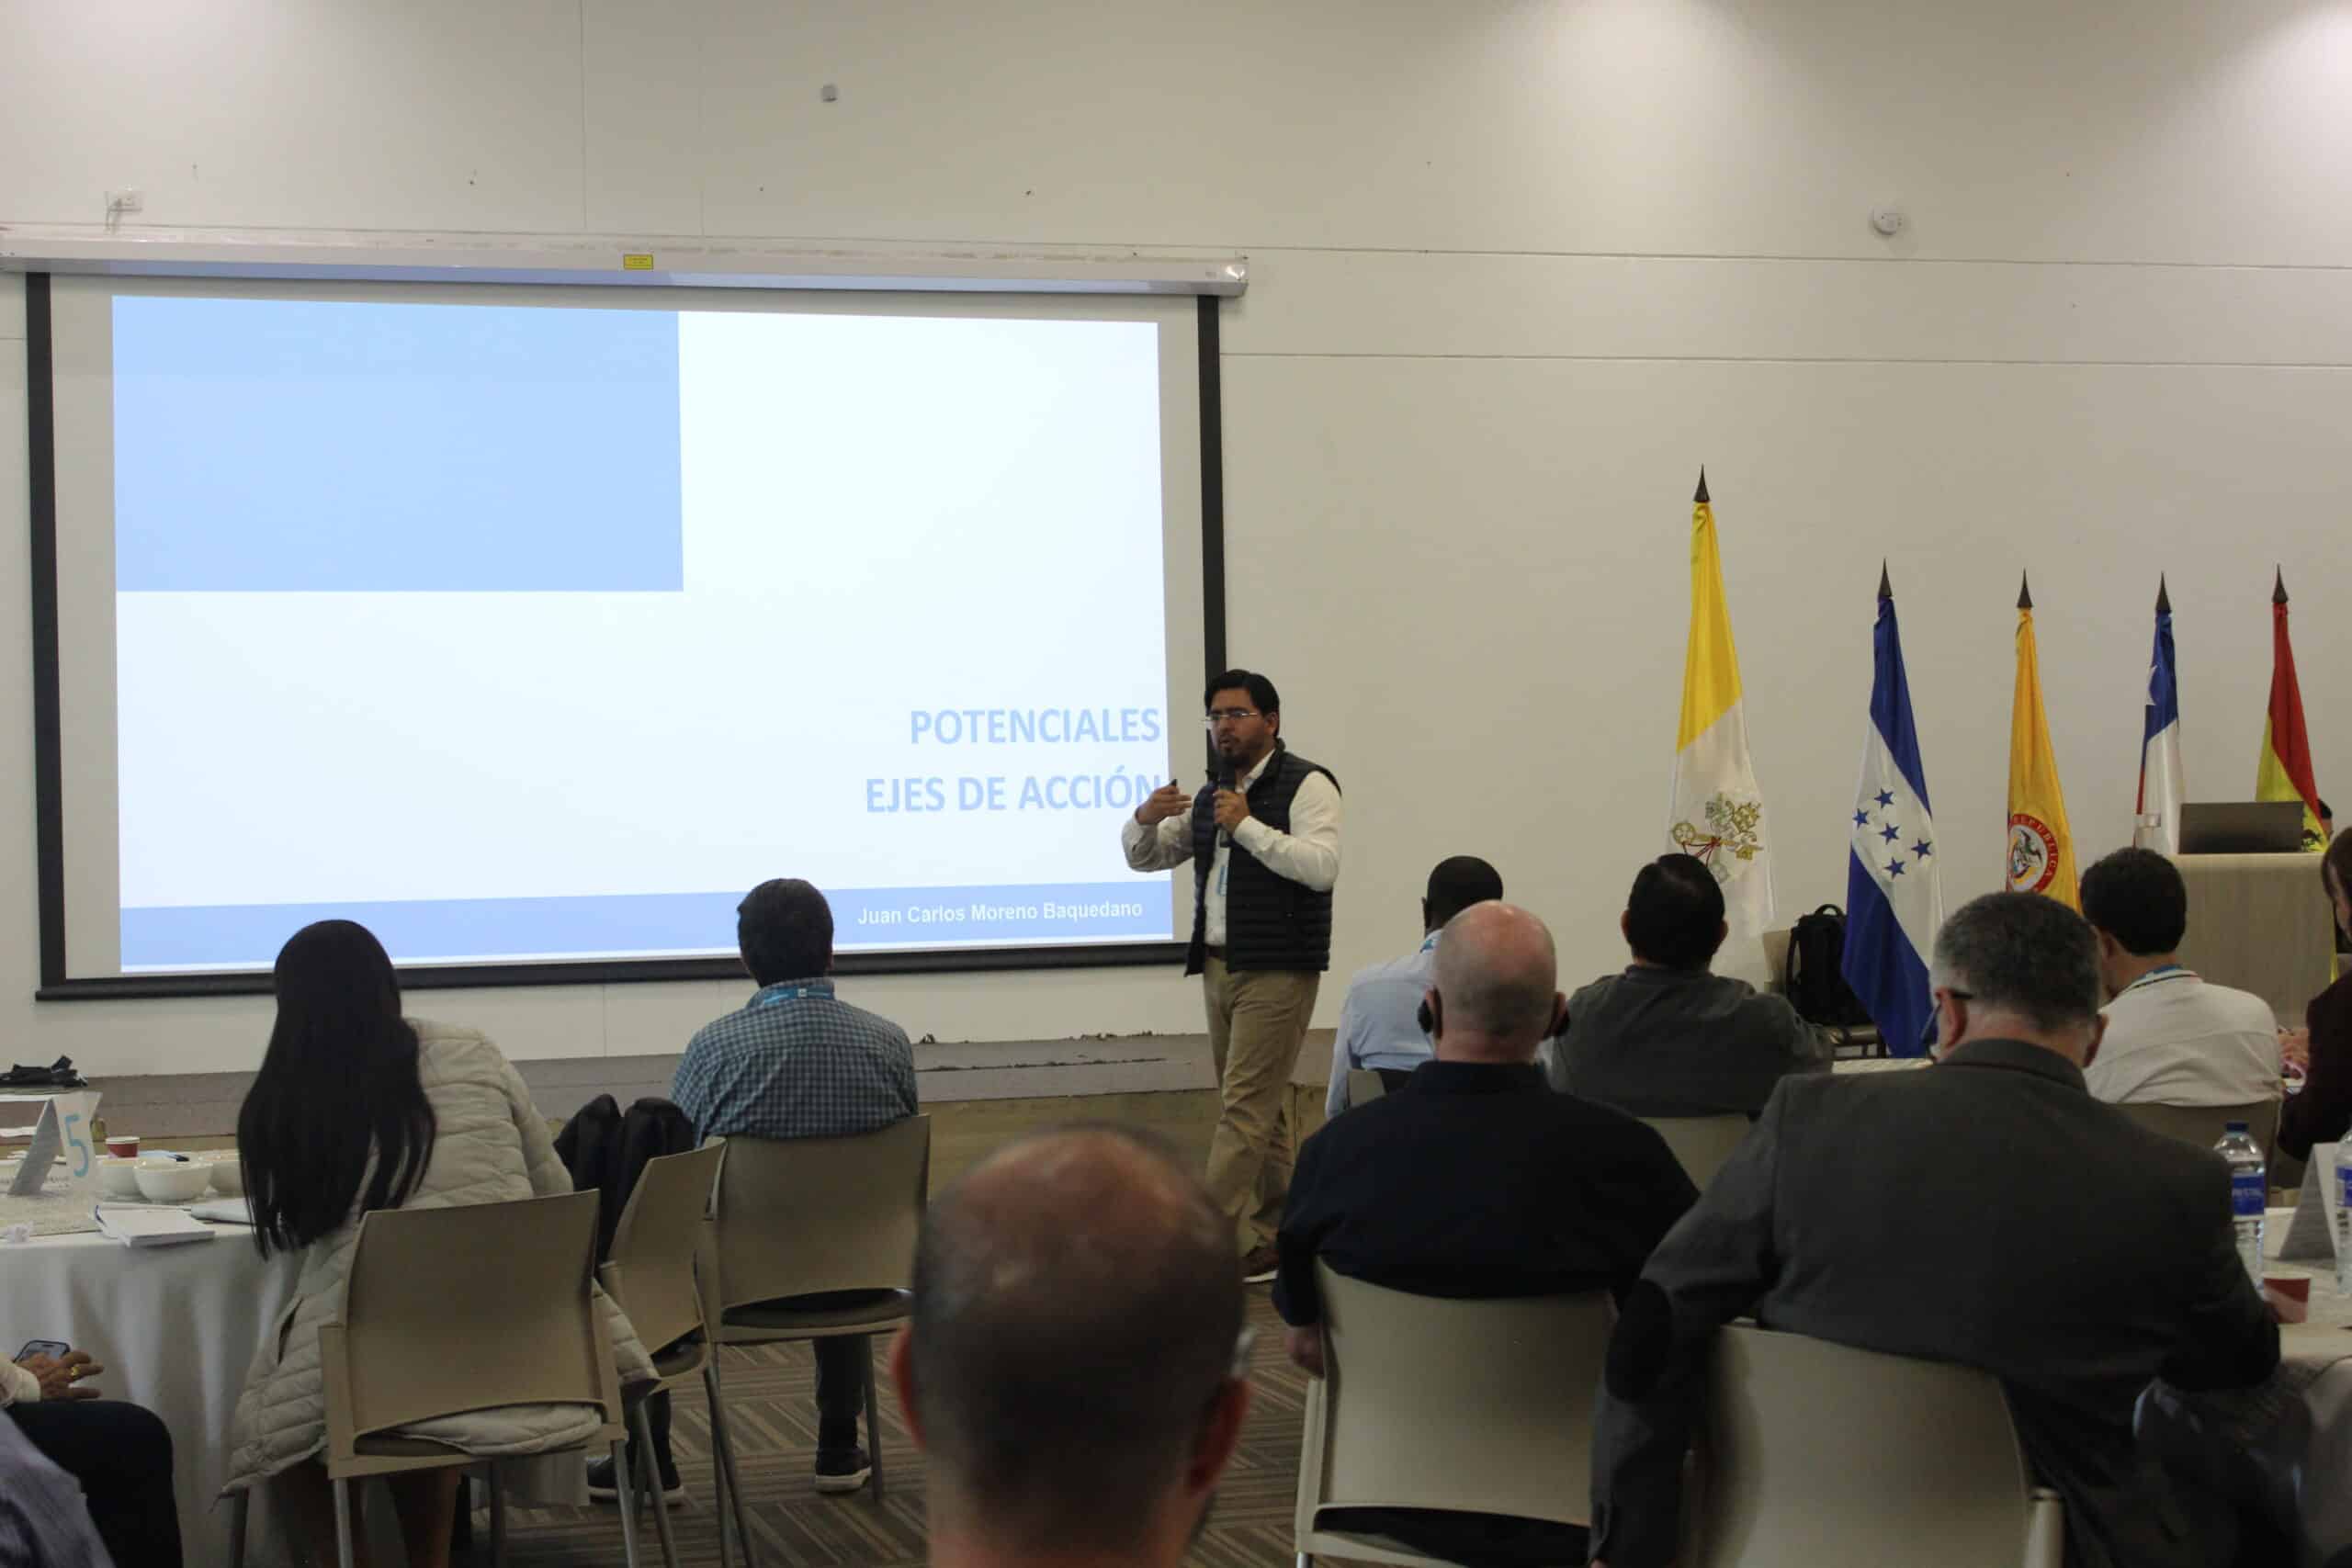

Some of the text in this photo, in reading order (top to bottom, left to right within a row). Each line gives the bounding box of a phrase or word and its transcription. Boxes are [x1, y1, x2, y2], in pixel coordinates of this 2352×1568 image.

[910, 708, 1160, 744] POTENCIALES
[866, 777, 944, 813] EJES
[958, 777, 1006, 811] DE
[858, 900, 1142, 925] Juan Carlos Moreno Baquedano
[64, 1114, 89, 1178] 5
